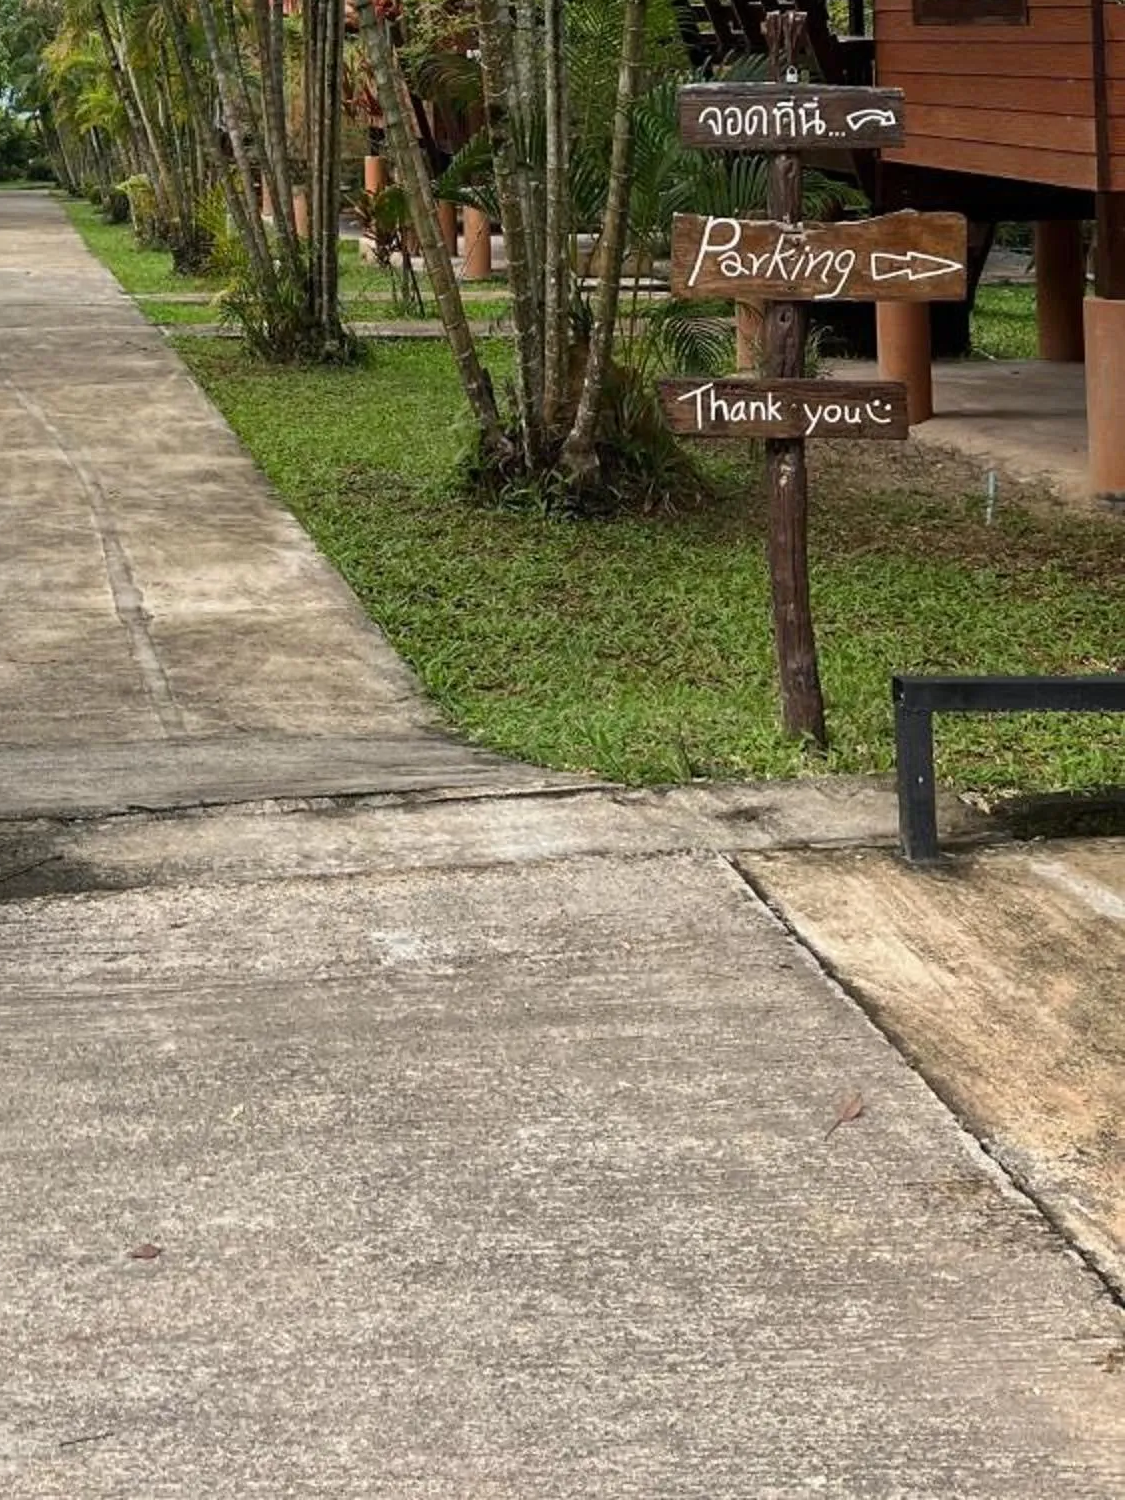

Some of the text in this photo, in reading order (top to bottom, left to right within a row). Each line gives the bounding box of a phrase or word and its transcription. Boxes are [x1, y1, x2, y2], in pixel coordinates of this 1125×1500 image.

[687, 216, 856, 299] Parking
[677, 383, 862, 435] Thank you
